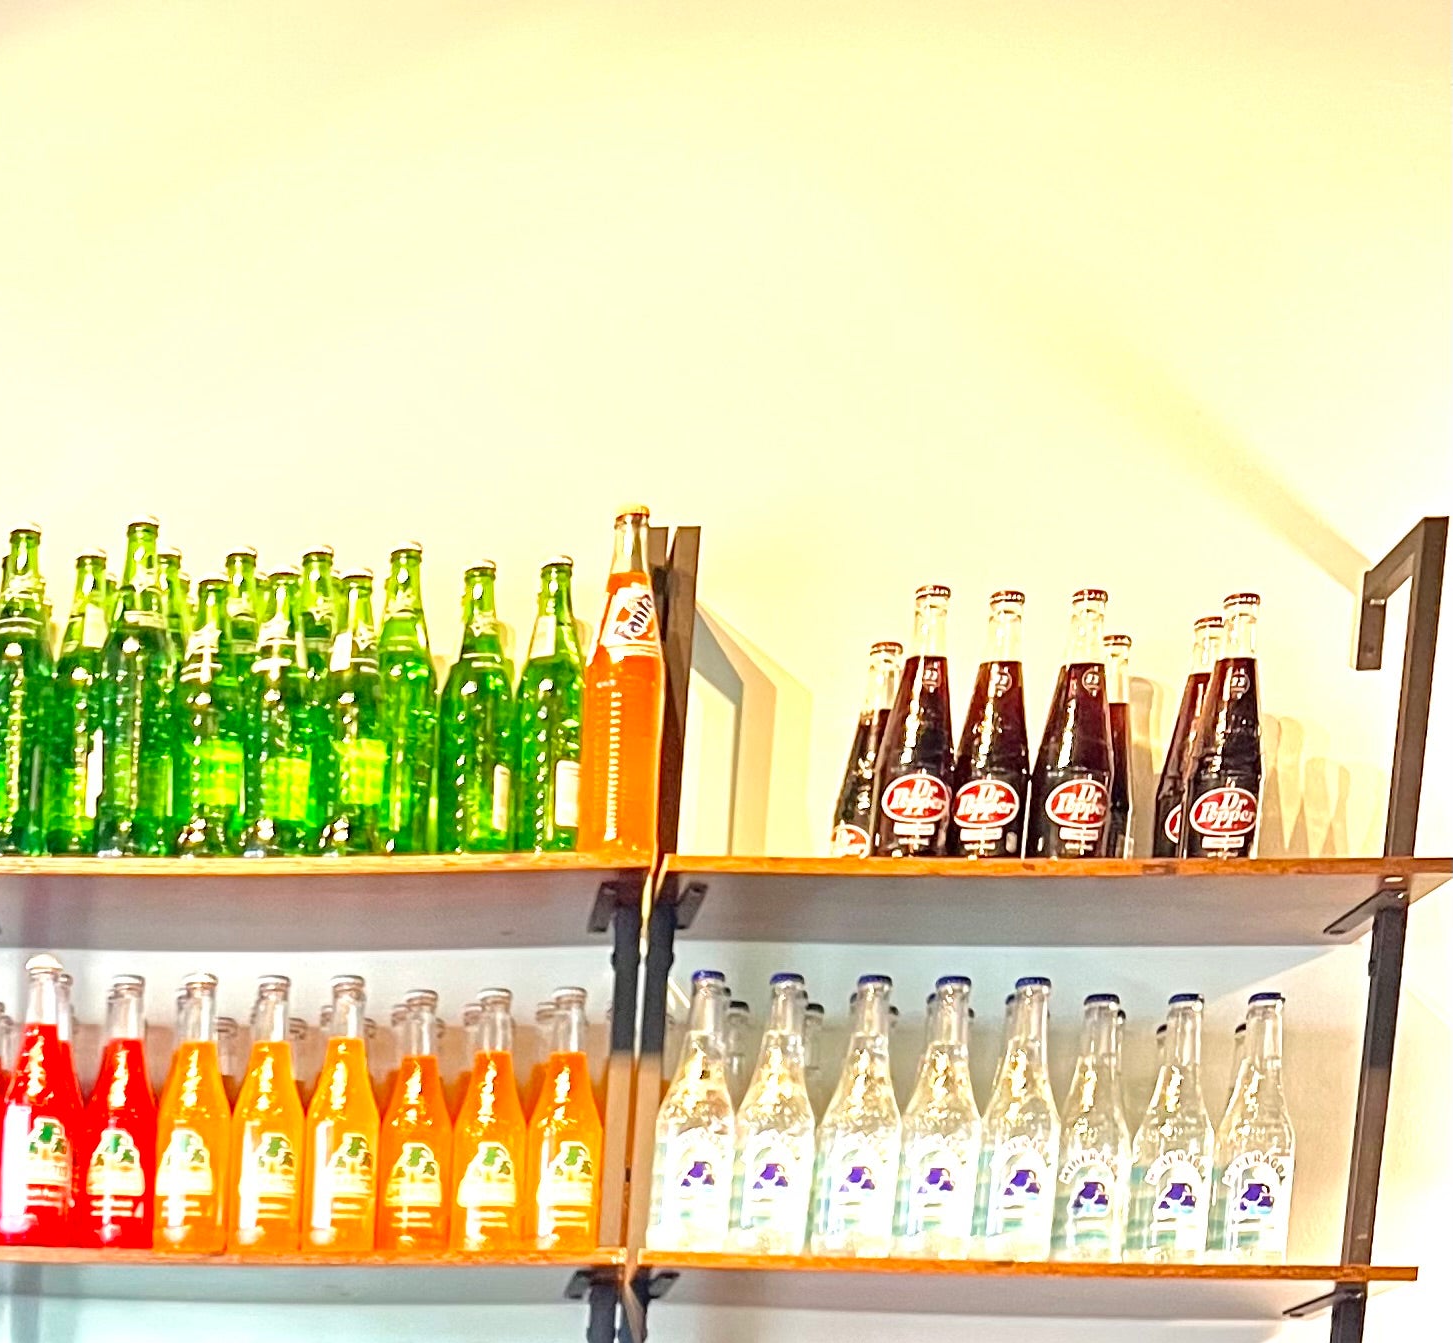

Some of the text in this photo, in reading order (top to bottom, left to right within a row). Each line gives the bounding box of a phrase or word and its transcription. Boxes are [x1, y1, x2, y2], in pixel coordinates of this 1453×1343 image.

[912, 778, 939, 799] Dr
[978, 784, 1007, 803] Dr
[1079, 783, 1102, 803] Dr
[1220, 791, 1248, 811] Dr
